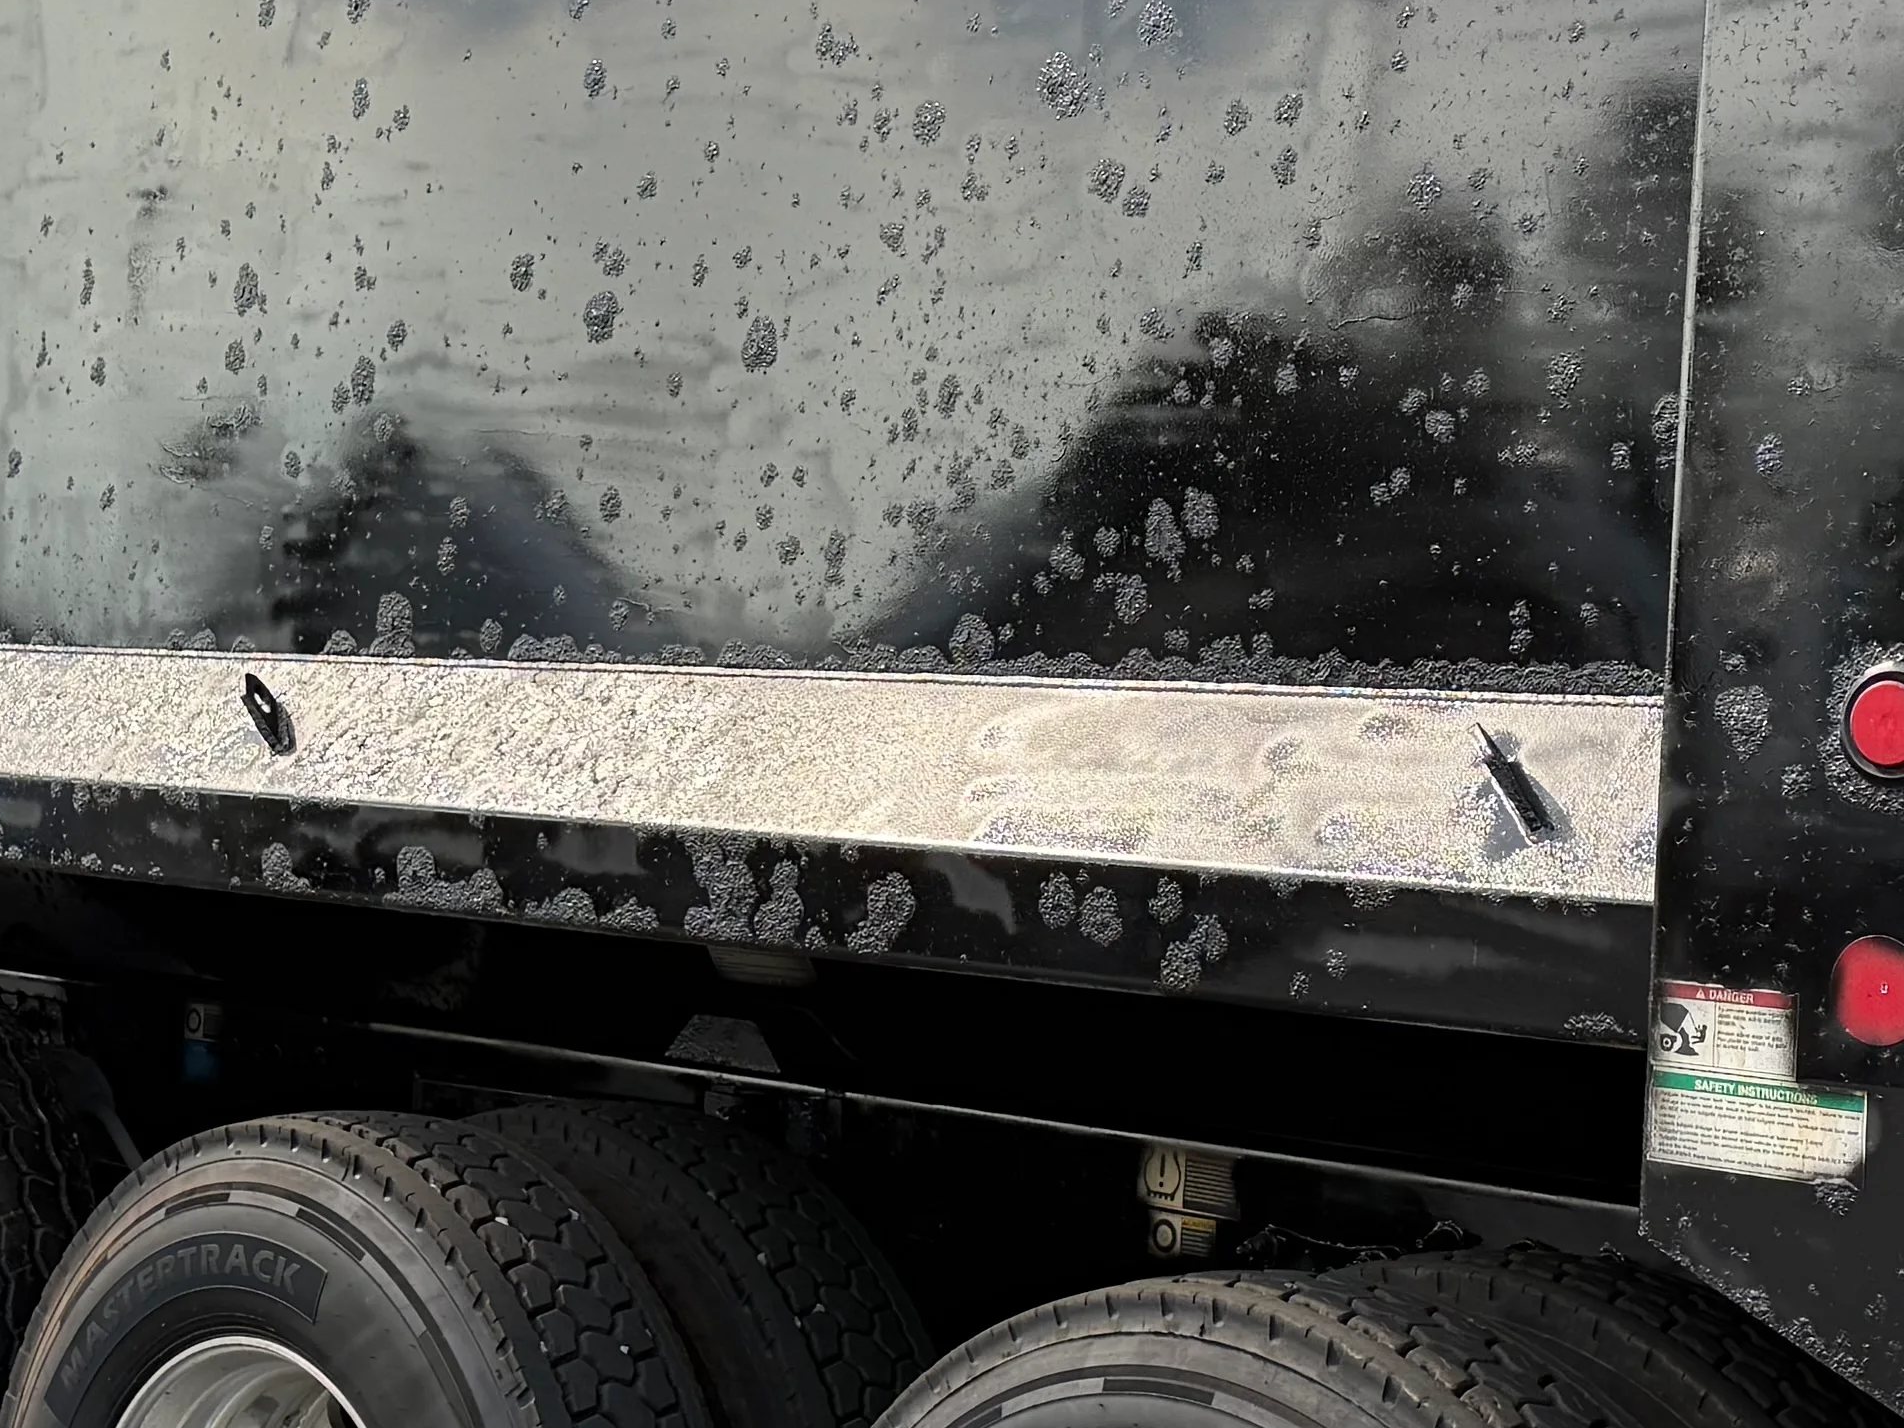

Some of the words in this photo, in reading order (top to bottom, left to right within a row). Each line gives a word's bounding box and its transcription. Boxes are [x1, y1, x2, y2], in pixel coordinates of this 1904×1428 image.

[1709, 988, 1754, 1004] DANGER
[1694, 1079, 1736, 1094] SAFETY
[1737, 1084, 1818, 1105] INSTRUCTIONS
[59, 1243, 301, 1389] MASTERTRACK
